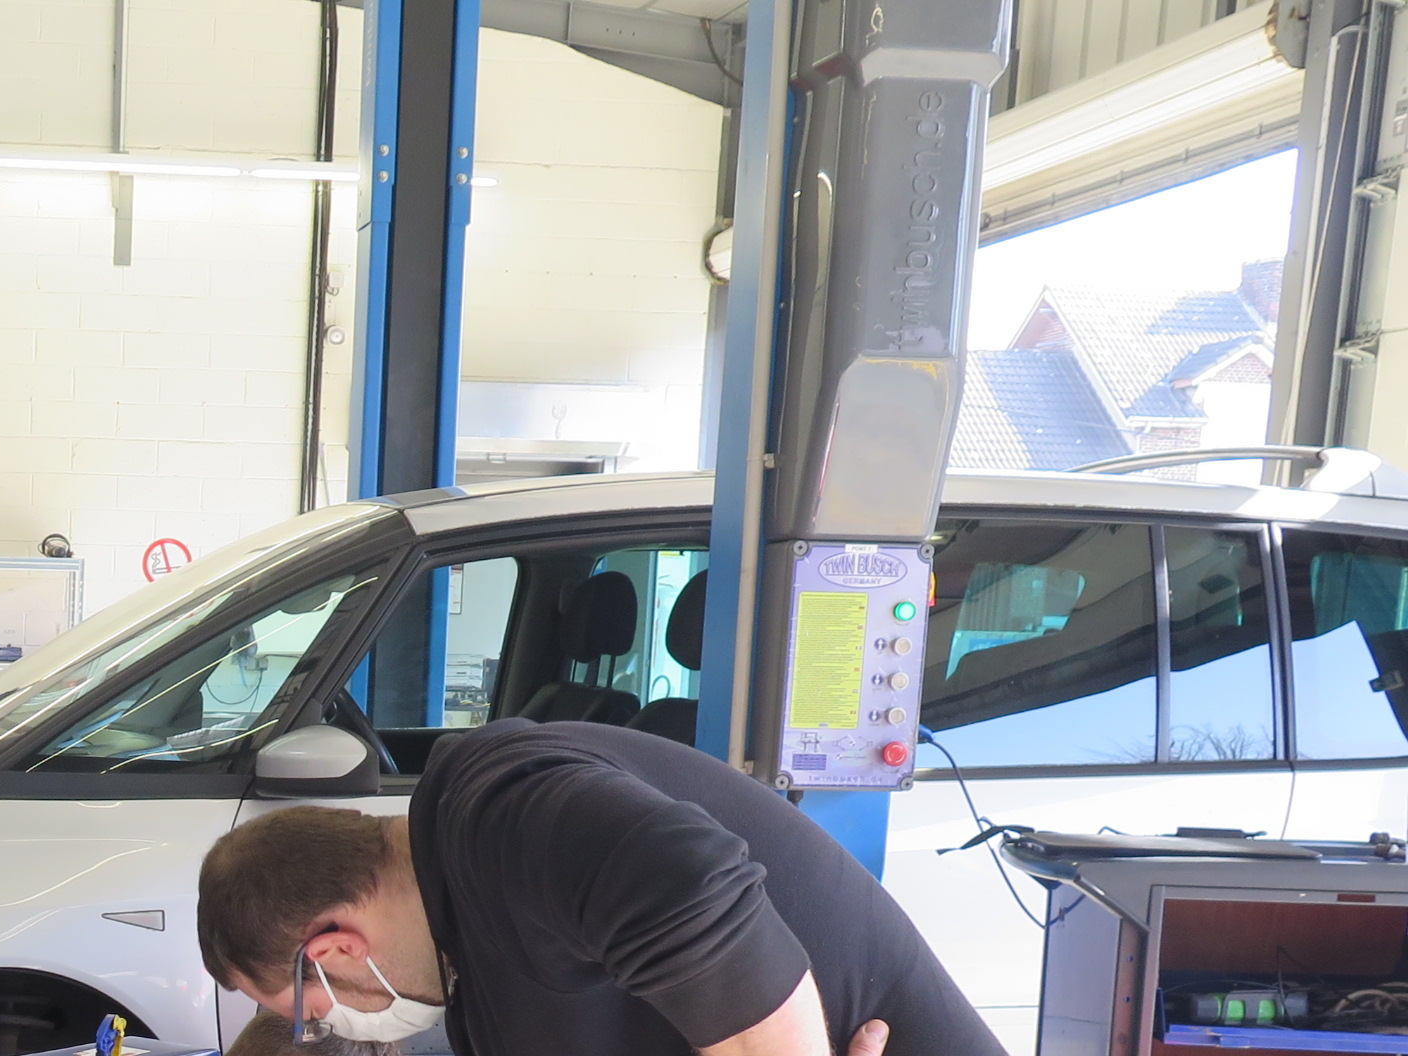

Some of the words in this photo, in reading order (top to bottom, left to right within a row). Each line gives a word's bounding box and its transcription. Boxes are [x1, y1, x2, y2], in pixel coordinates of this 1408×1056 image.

[886, 88, 946, 351] twinbusch.de
[824, 554, 856, 574] TWIN
[857, 554, 902, 576] BUSCH
